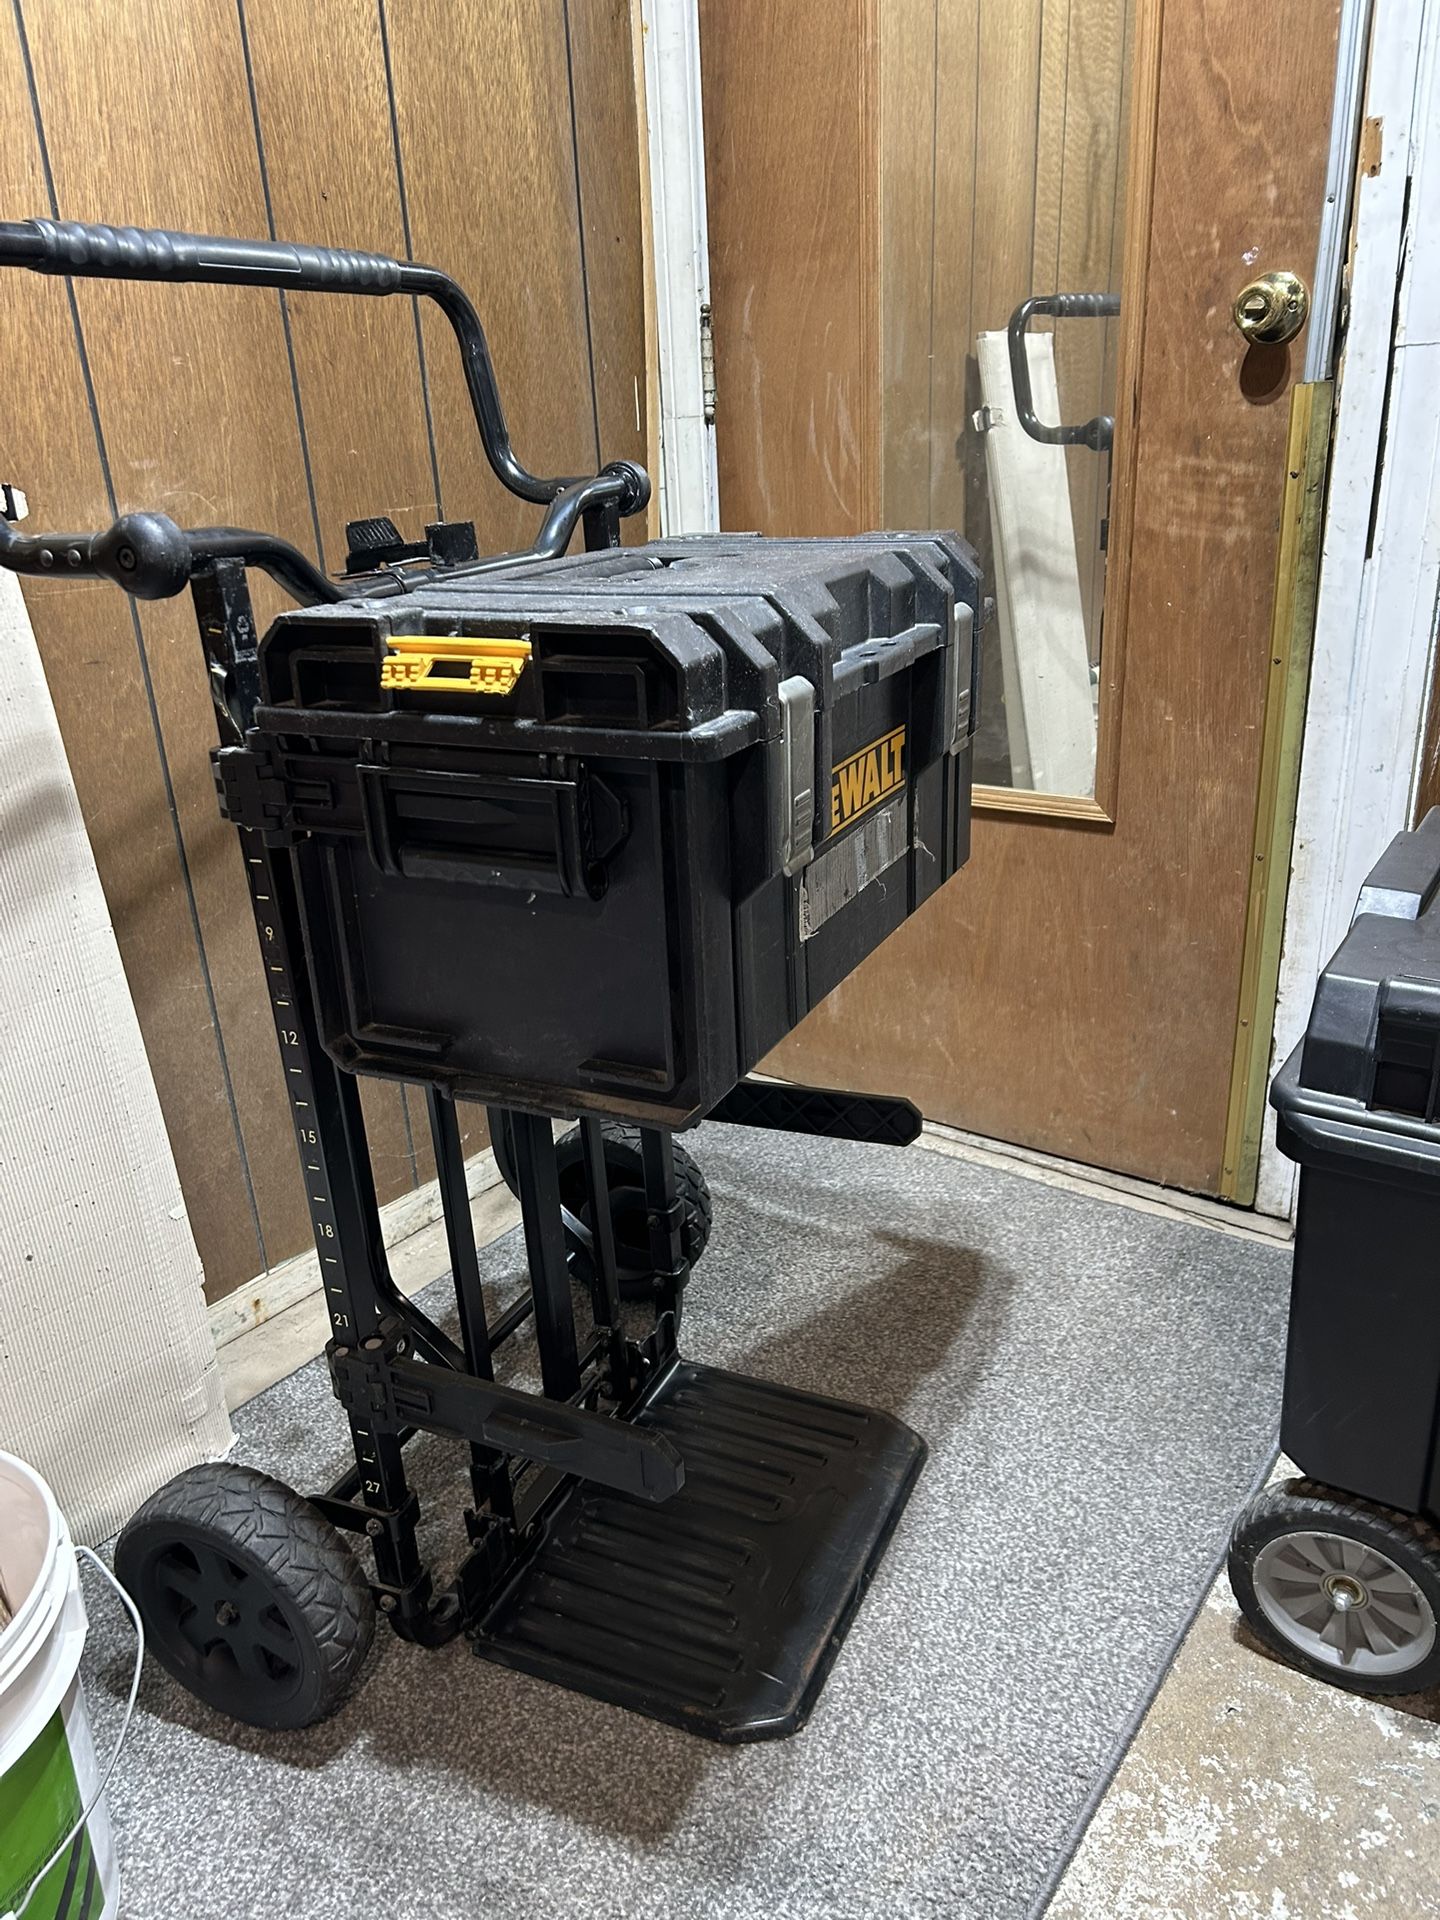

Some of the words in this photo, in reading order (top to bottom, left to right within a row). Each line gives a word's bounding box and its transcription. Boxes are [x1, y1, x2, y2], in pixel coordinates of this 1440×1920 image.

[831, 730, 906, 828] EWALT
[265, 926, 274, 941] 9
[281, 1030, 299, 1046] 12
[300, 1129, 317, 1144] 15
[317, 1222, 334, 1238] 18
[333, 1312, 349, 1328] 21
[365, 1479, 381, 1494] 27
